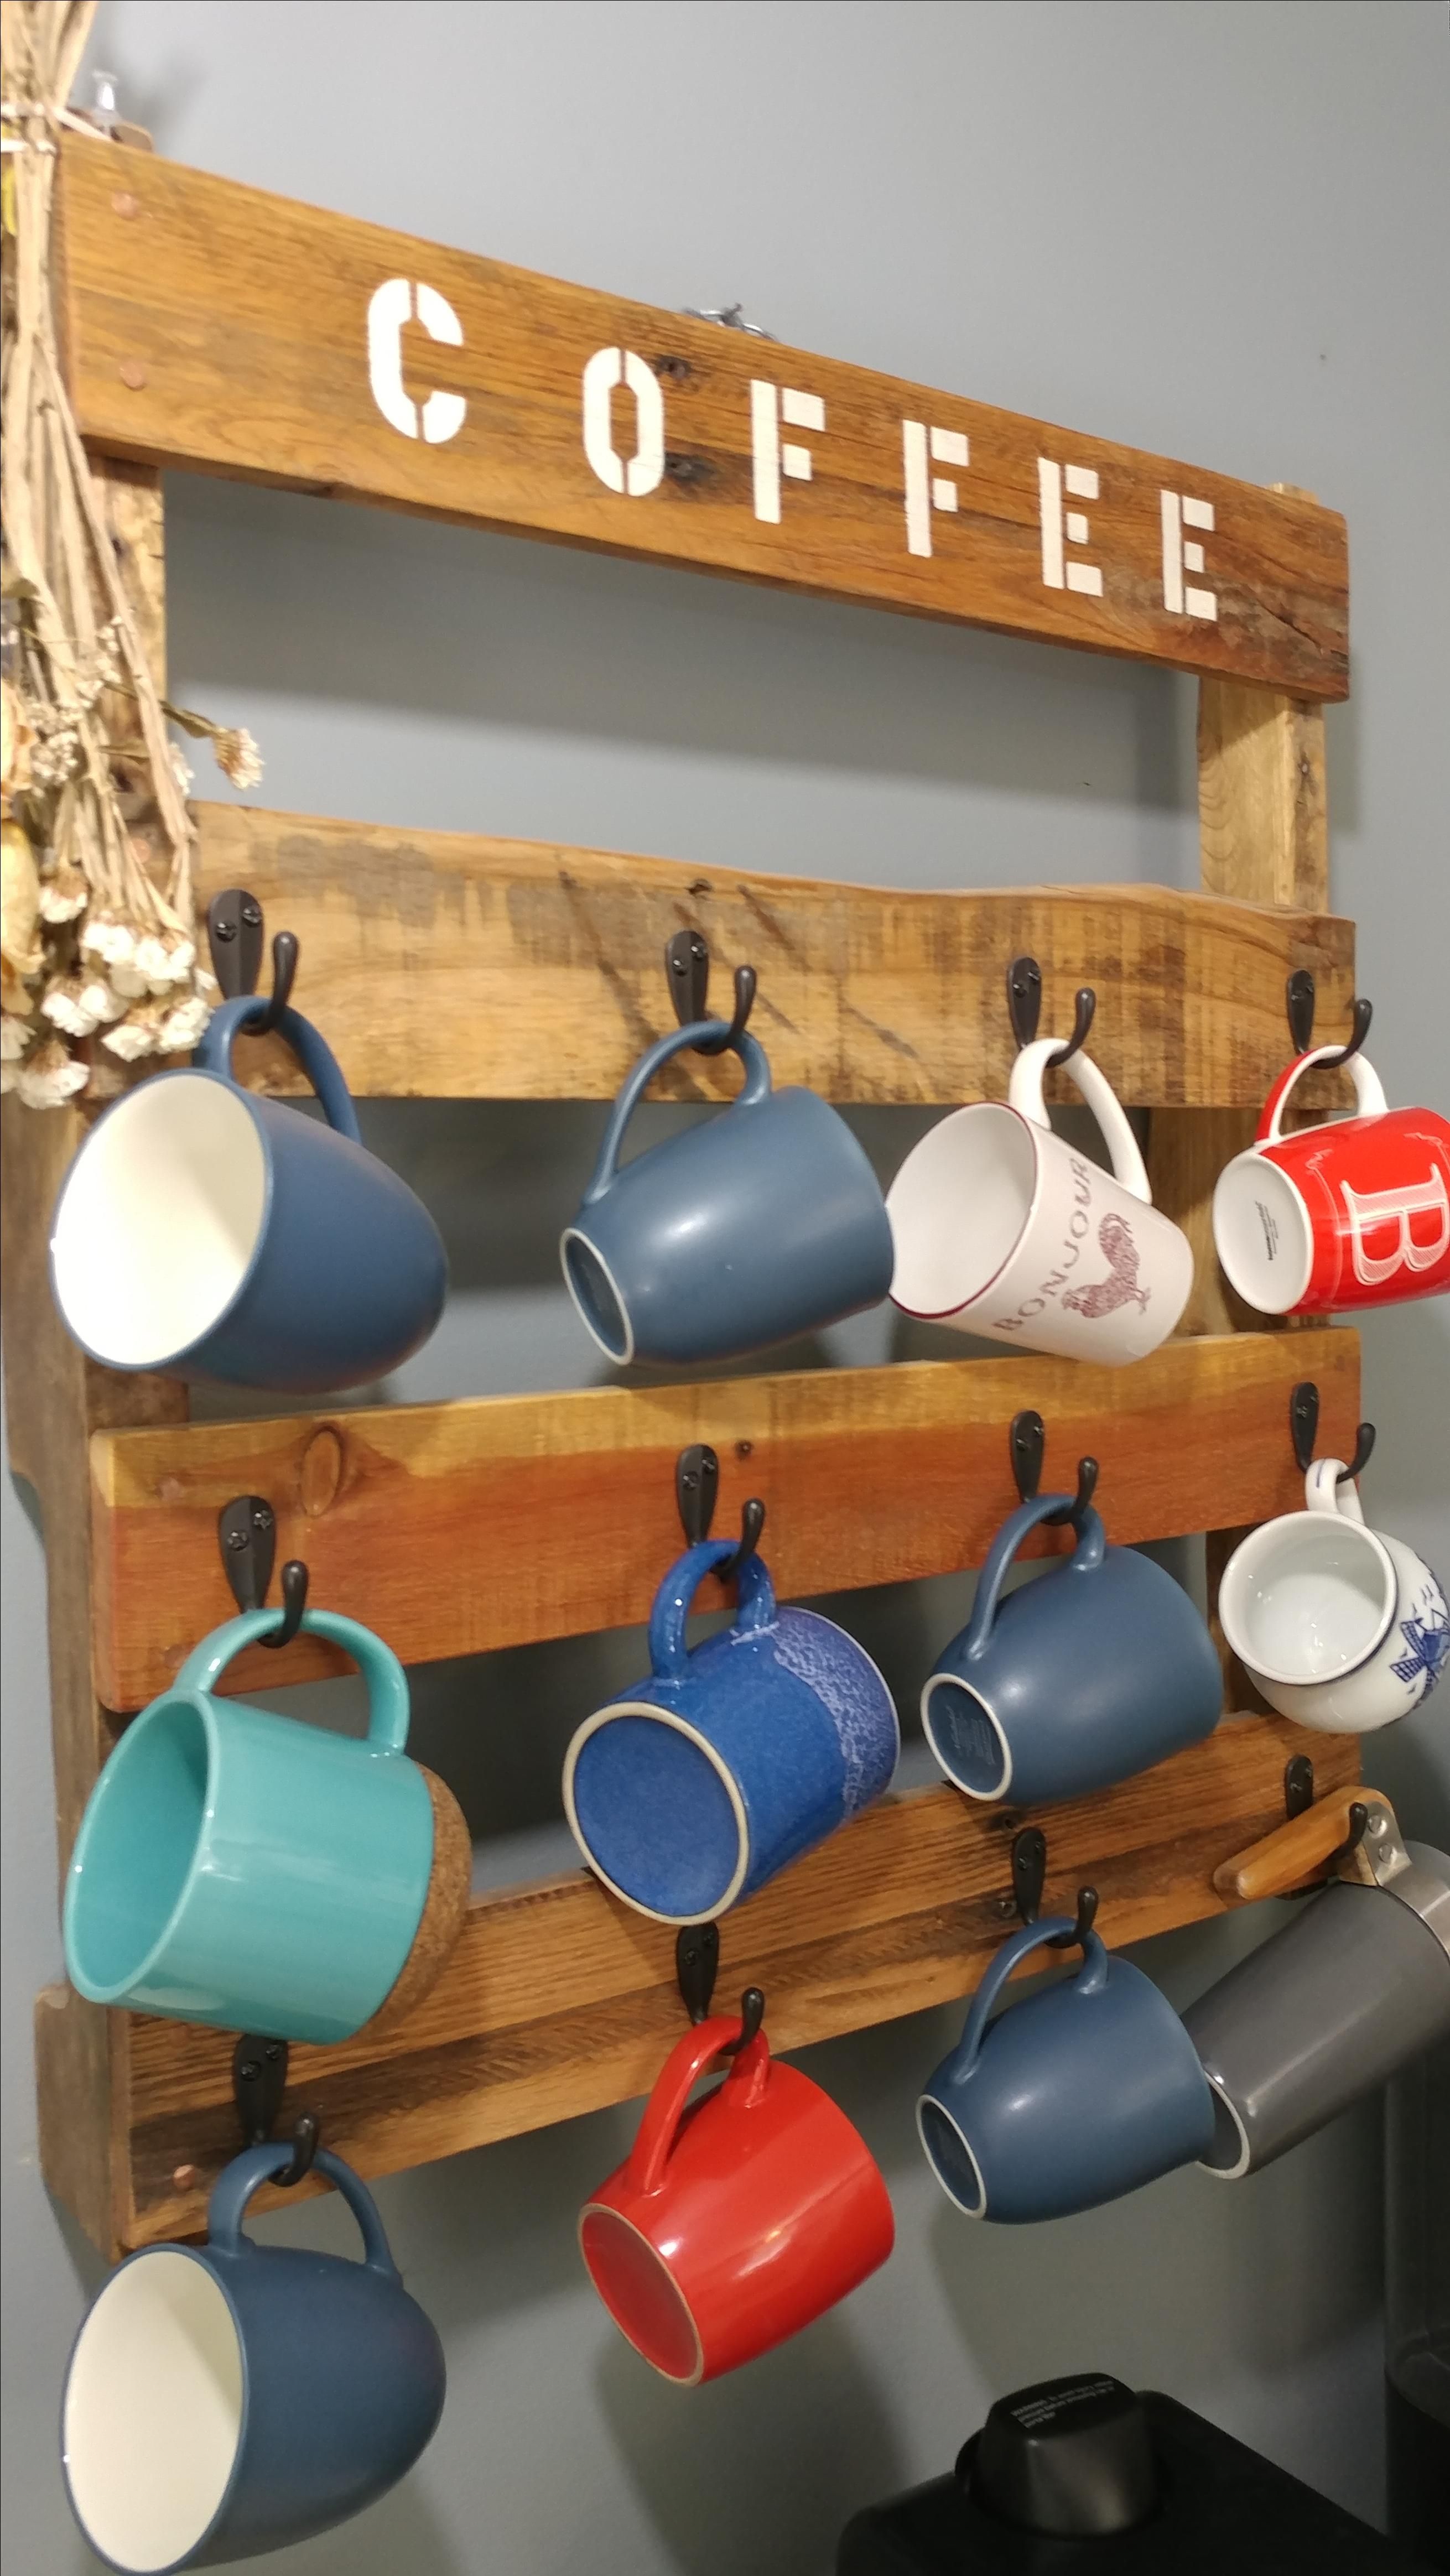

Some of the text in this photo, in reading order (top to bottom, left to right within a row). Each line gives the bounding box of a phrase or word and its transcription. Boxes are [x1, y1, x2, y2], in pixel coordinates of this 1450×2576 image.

[366, 278, 1217, 621] COFFEE
[994, 1158, 1092, 1331] BONJOUR
[1340, 1163, 1449, 1286] B
